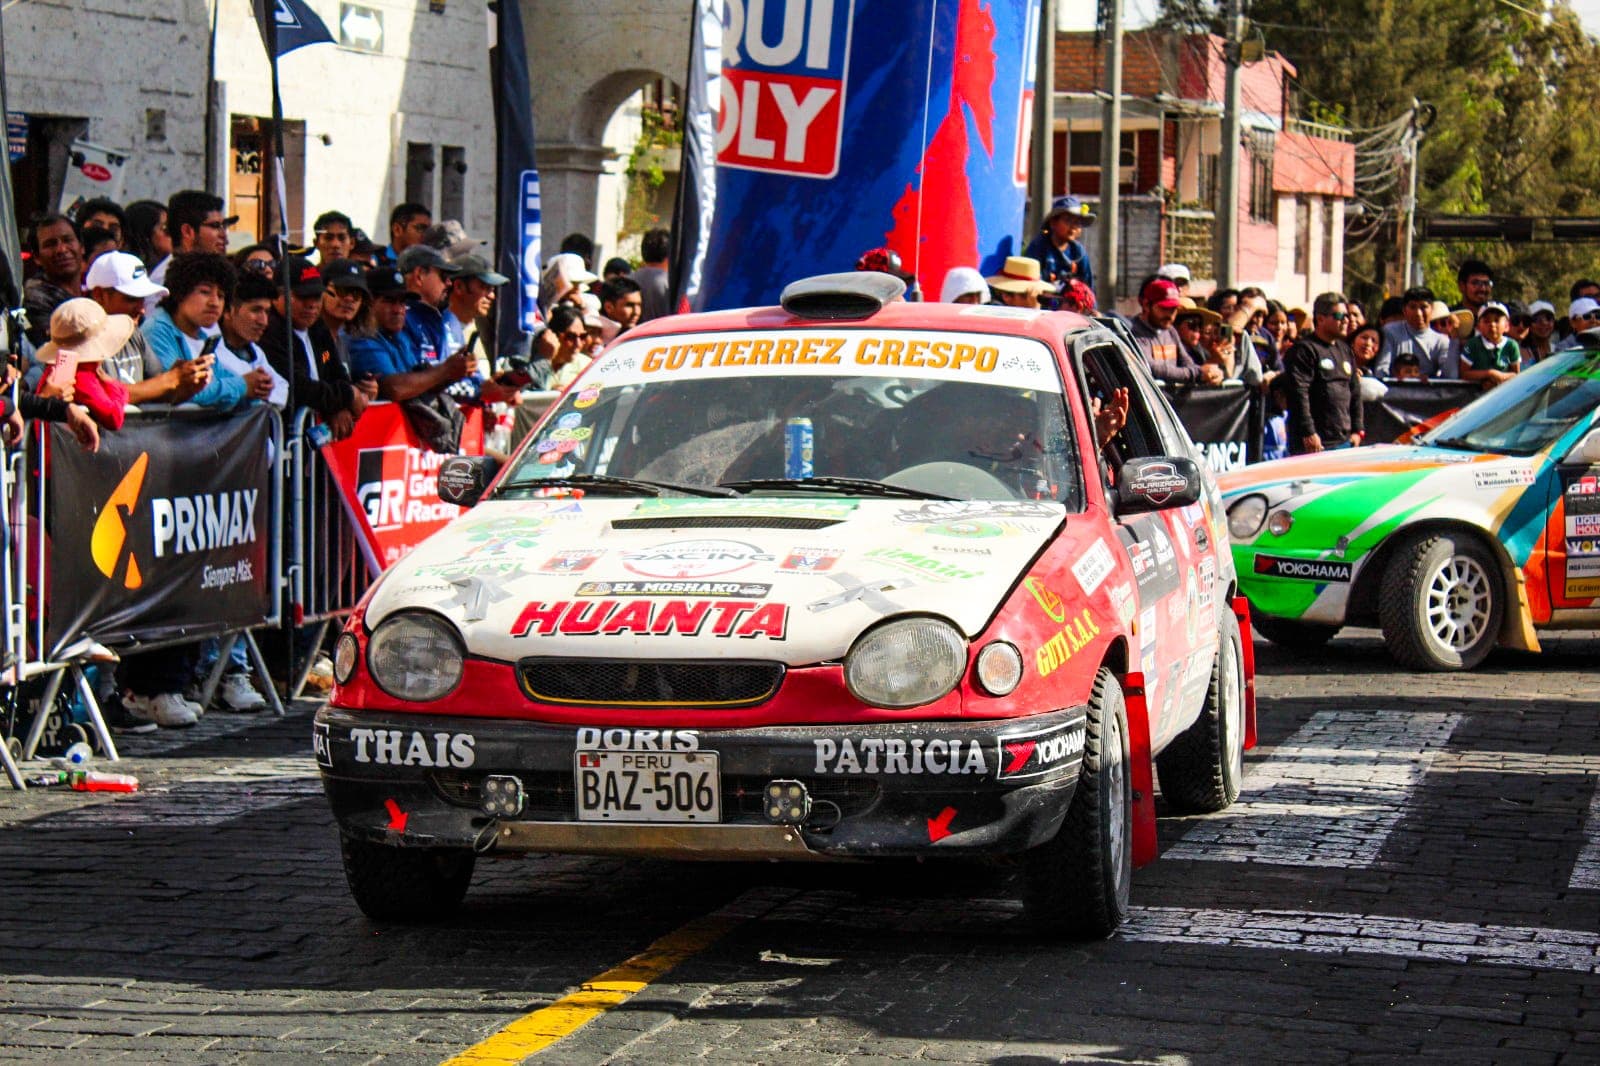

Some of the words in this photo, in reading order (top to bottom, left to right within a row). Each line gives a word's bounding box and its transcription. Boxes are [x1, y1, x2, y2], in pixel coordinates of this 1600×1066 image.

[641, 339, 848, 373] GUTIERREZ
[854, 343, 1000, 373] CRESPO
[1131, 478, 1186, 490] POLARIZADOS
[1568, 483, 1595, 494] GR
[356, 478, 406, 529] GR
[152, 489, 258, 557] PRIMAX
[1576, 516, 1600, 525] LIQU
[621, 553, 776, 561] RACING
[201, 565, 236, 589] Siempre
[1277, 561, 1349, 579] YOKOHAMA
[612, 583, 637, 592] EL
[642, 582, 740, 593] MOSHAKO
[510, 600, 789, 641] HUANTA
[1036, 631, 1071, 677] GUTI
[351, 728, 475, 769] THAIS
[576, 728, 701, 752] DORIS
[621, 755, 672, 770] PERU
[814, 739, 988, 774] PATRICIA
[582, 770, 713, 812] BAZ-506
